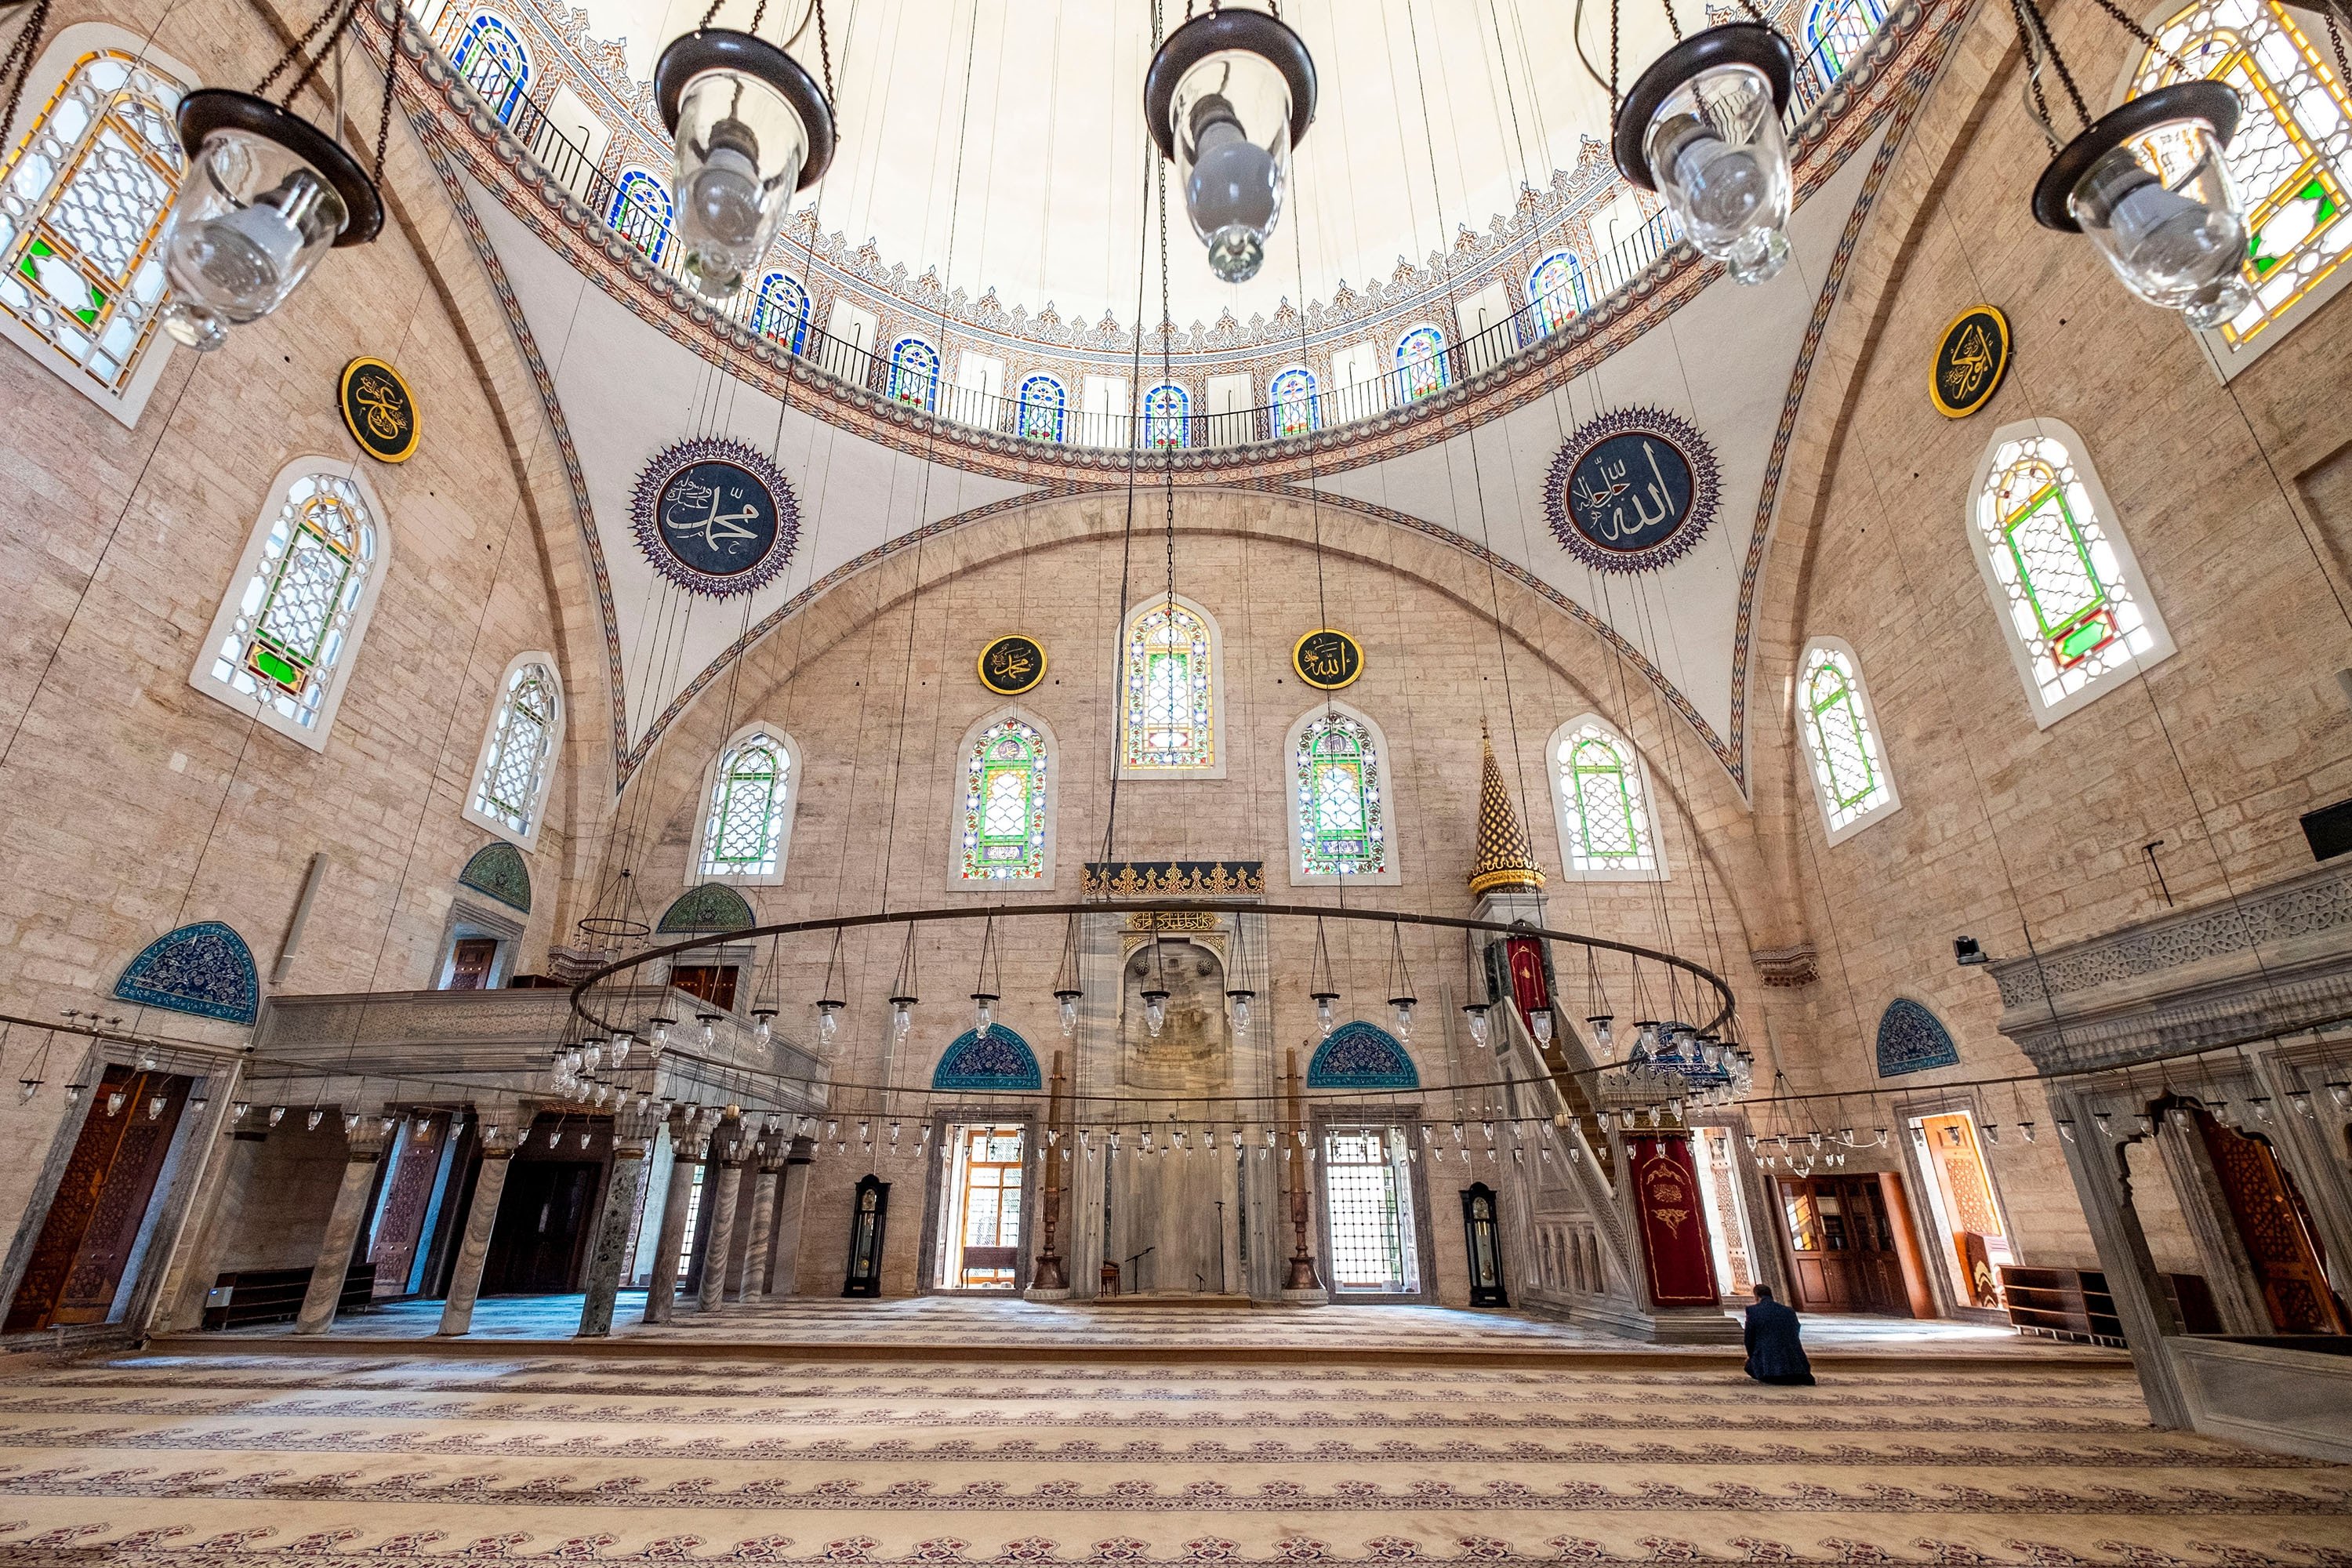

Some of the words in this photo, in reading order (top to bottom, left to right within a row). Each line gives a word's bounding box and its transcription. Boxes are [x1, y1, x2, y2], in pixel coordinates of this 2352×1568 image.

[1599, 441, 1675, 542] الله
[665, 486, 760, 553] محمد
[993, 654, 1031, 680] محمد
[1311, 641, 1346, 677] الله
